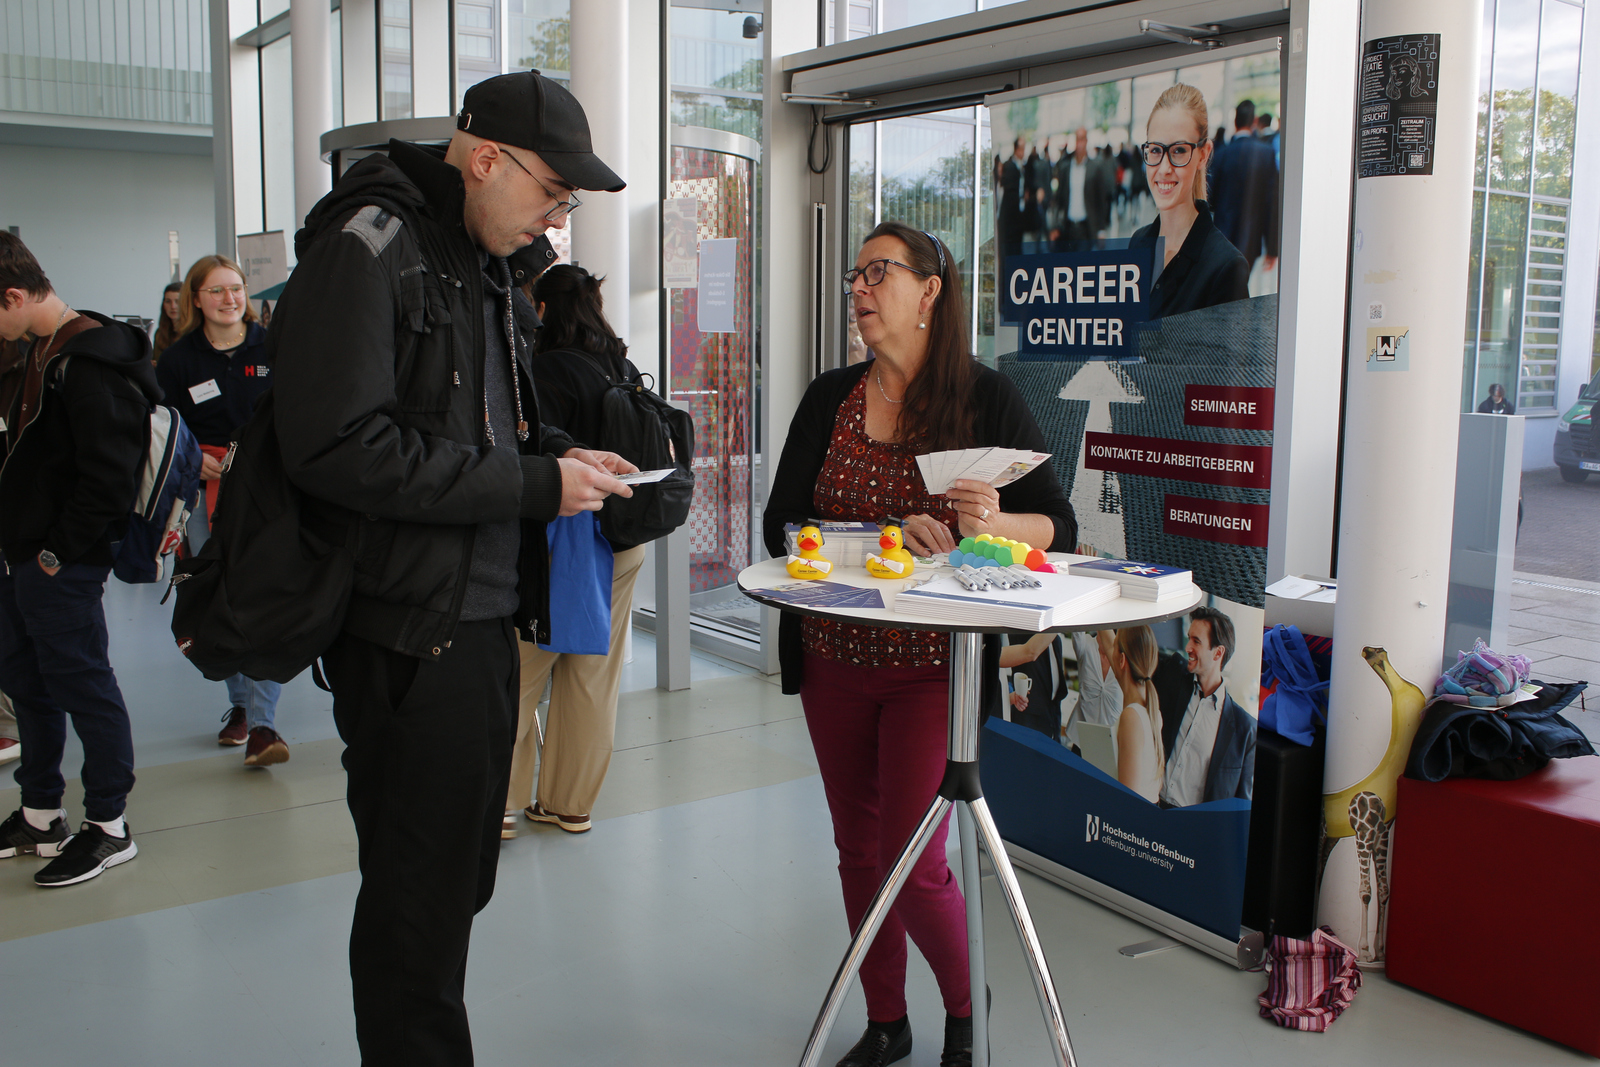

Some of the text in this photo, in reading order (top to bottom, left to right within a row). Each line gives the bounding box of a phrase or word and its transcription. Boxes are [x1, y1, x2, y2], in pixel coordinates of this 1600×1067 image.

[1366, 54, 1383, 62] PROJECT
[1366, 60, 1383, 72] KATIE
[1362, 112, 1388, 122] GESUCHT
[1370, 127, 1388, 136] PROFIL
[1010, 264, 1140, 305] CAREER
[1027, 318, 1123, 346] CENTER
[1190, 399, 1257, 415] SEMINARE
[1090, 445, 1254, 473] KONTAKTE ZU ARBEITGEBERN
[1170, 508, 1252, 531] BERATUNGEN
[1102, 822, 1195, 868] Hochschule Offenburg
[1102, 836, 1174, 872] offenburg.university
